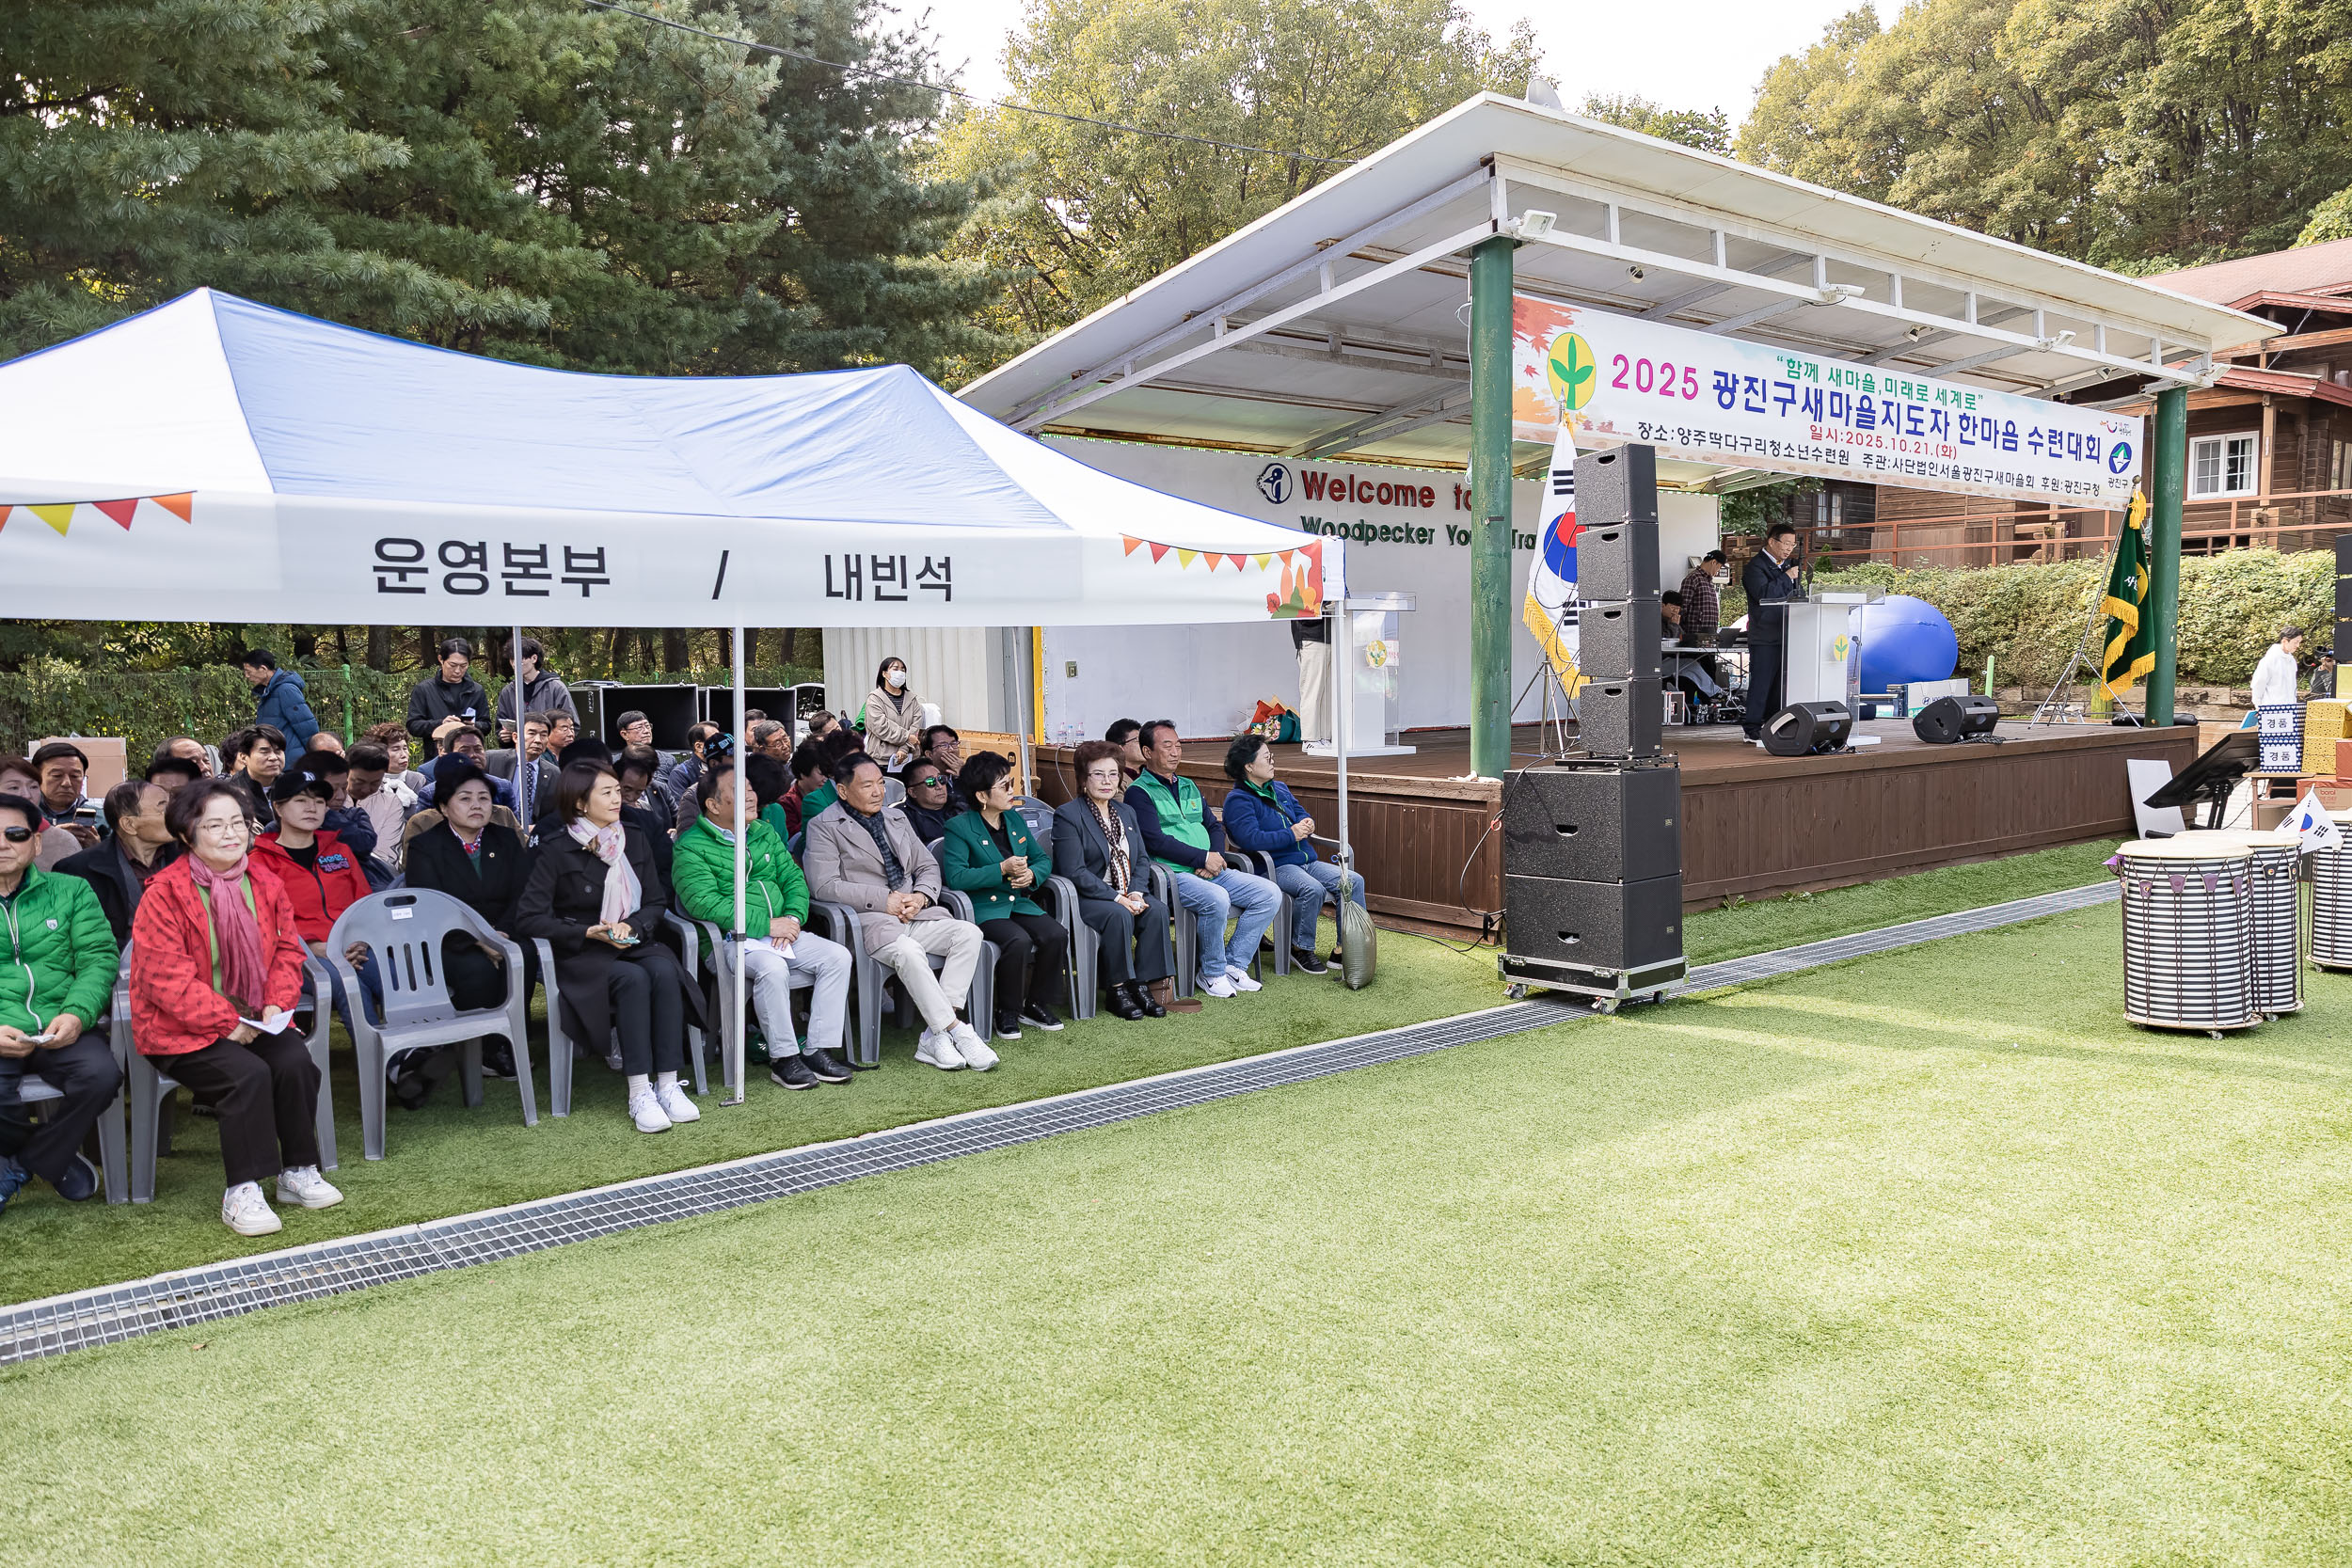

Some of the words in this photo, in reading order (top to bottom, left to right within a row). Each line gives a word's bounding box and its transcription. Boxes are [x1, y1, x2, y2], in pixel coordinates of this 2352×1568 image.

[1612, 354, 1699, 400] 2025
[1959, 412, 2019, 452] 한마음
[2027, 426, 2101, 464] 수련대회
[1809, 424, 1957, 459] 일시:2025.10.21.(화)
[1301, 470, 1436, 508] Welcome
[2041, 476, 2101, 497] 후원:광진구청
[2108, 477, 2128, 489] 광진구
[1300, 515, 1435, 546] Woodpecker
[373, 537, 611, 597] 운영본부
[711, 550, 730, 600] /
[824, 554, 952, 601] 내빈석
